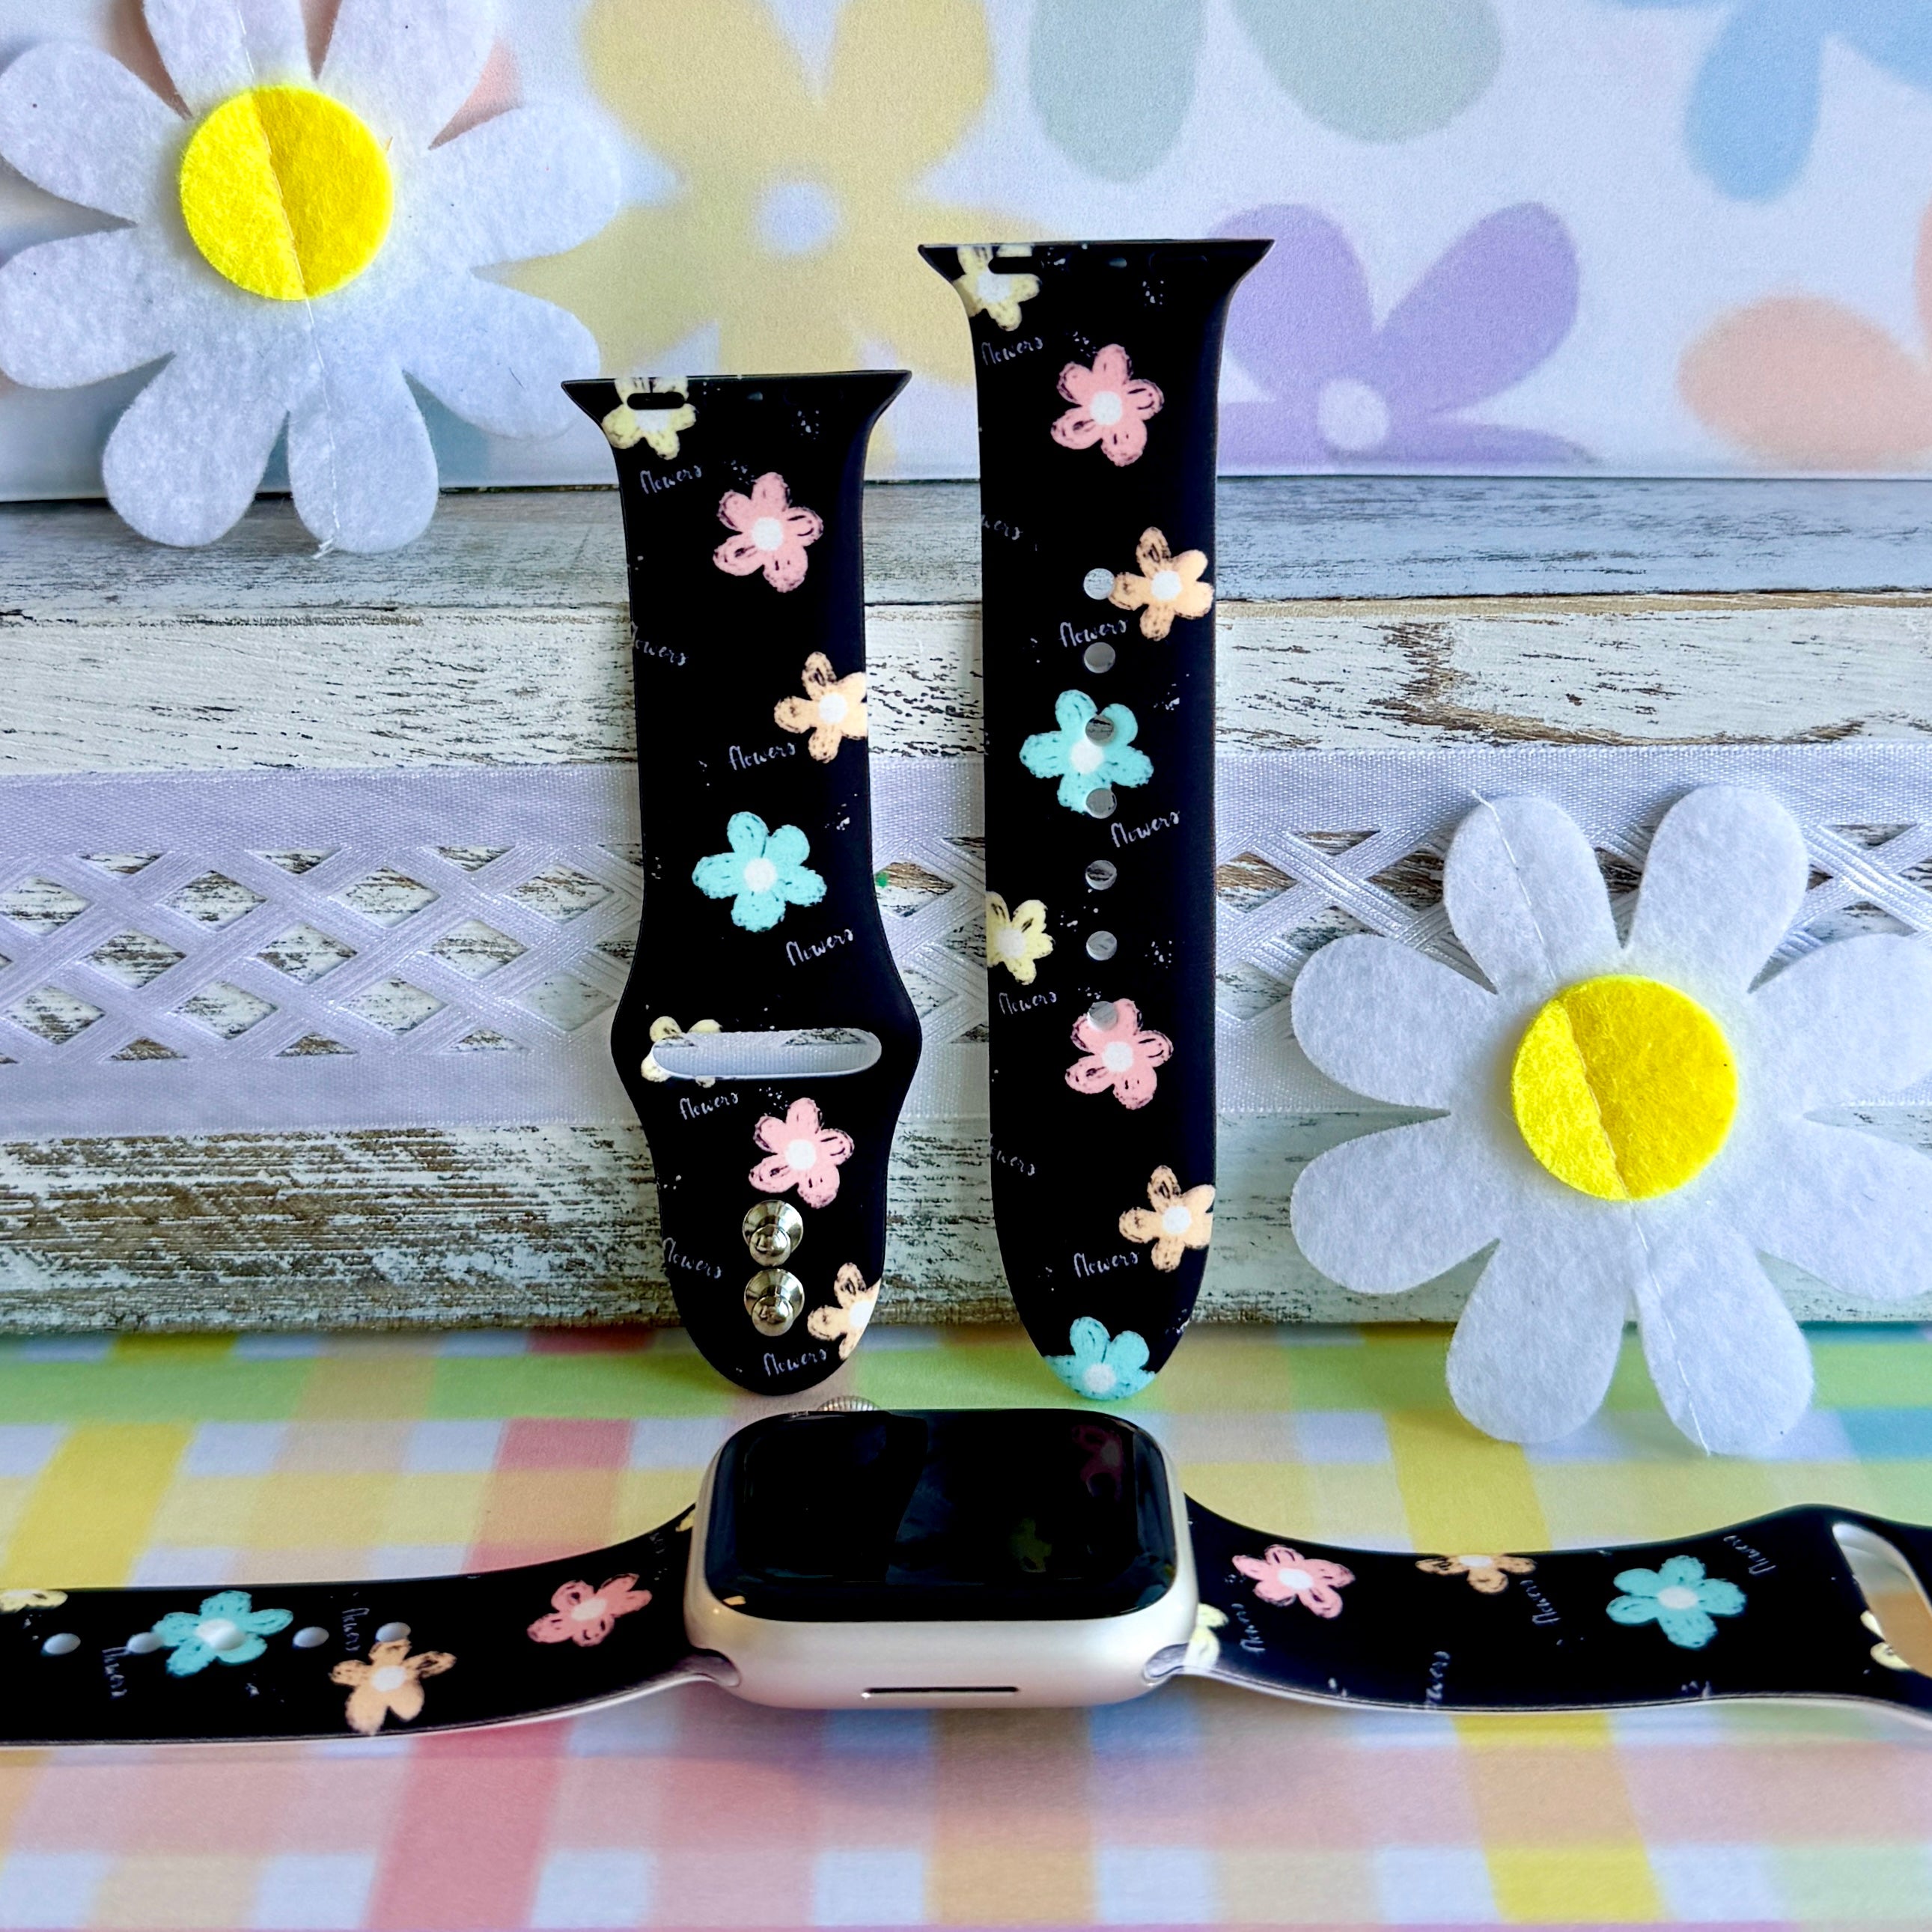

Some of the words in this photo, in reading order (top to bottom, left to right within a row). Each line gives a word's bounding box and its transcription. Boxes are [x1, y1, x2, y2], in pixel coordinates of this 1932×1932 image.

[981, 336, 1043, 366] flowers
[640, 465, 701, 495] flowers
[1060, 619, 1127, 647] flowers
[728, 742, 796, 772] flowers
[1110, 810, 1180, 848] flowers
[786, 928, 853, 966] flowers
[999, 991, 1057, 1016] flowers
[679, 1092, 739, 1121] flowers
[662, 1237, 722, 1279] flowers
[1073, 1250, 1139, 1279] flowers
[763, 1348, 827, 1377] flowers
